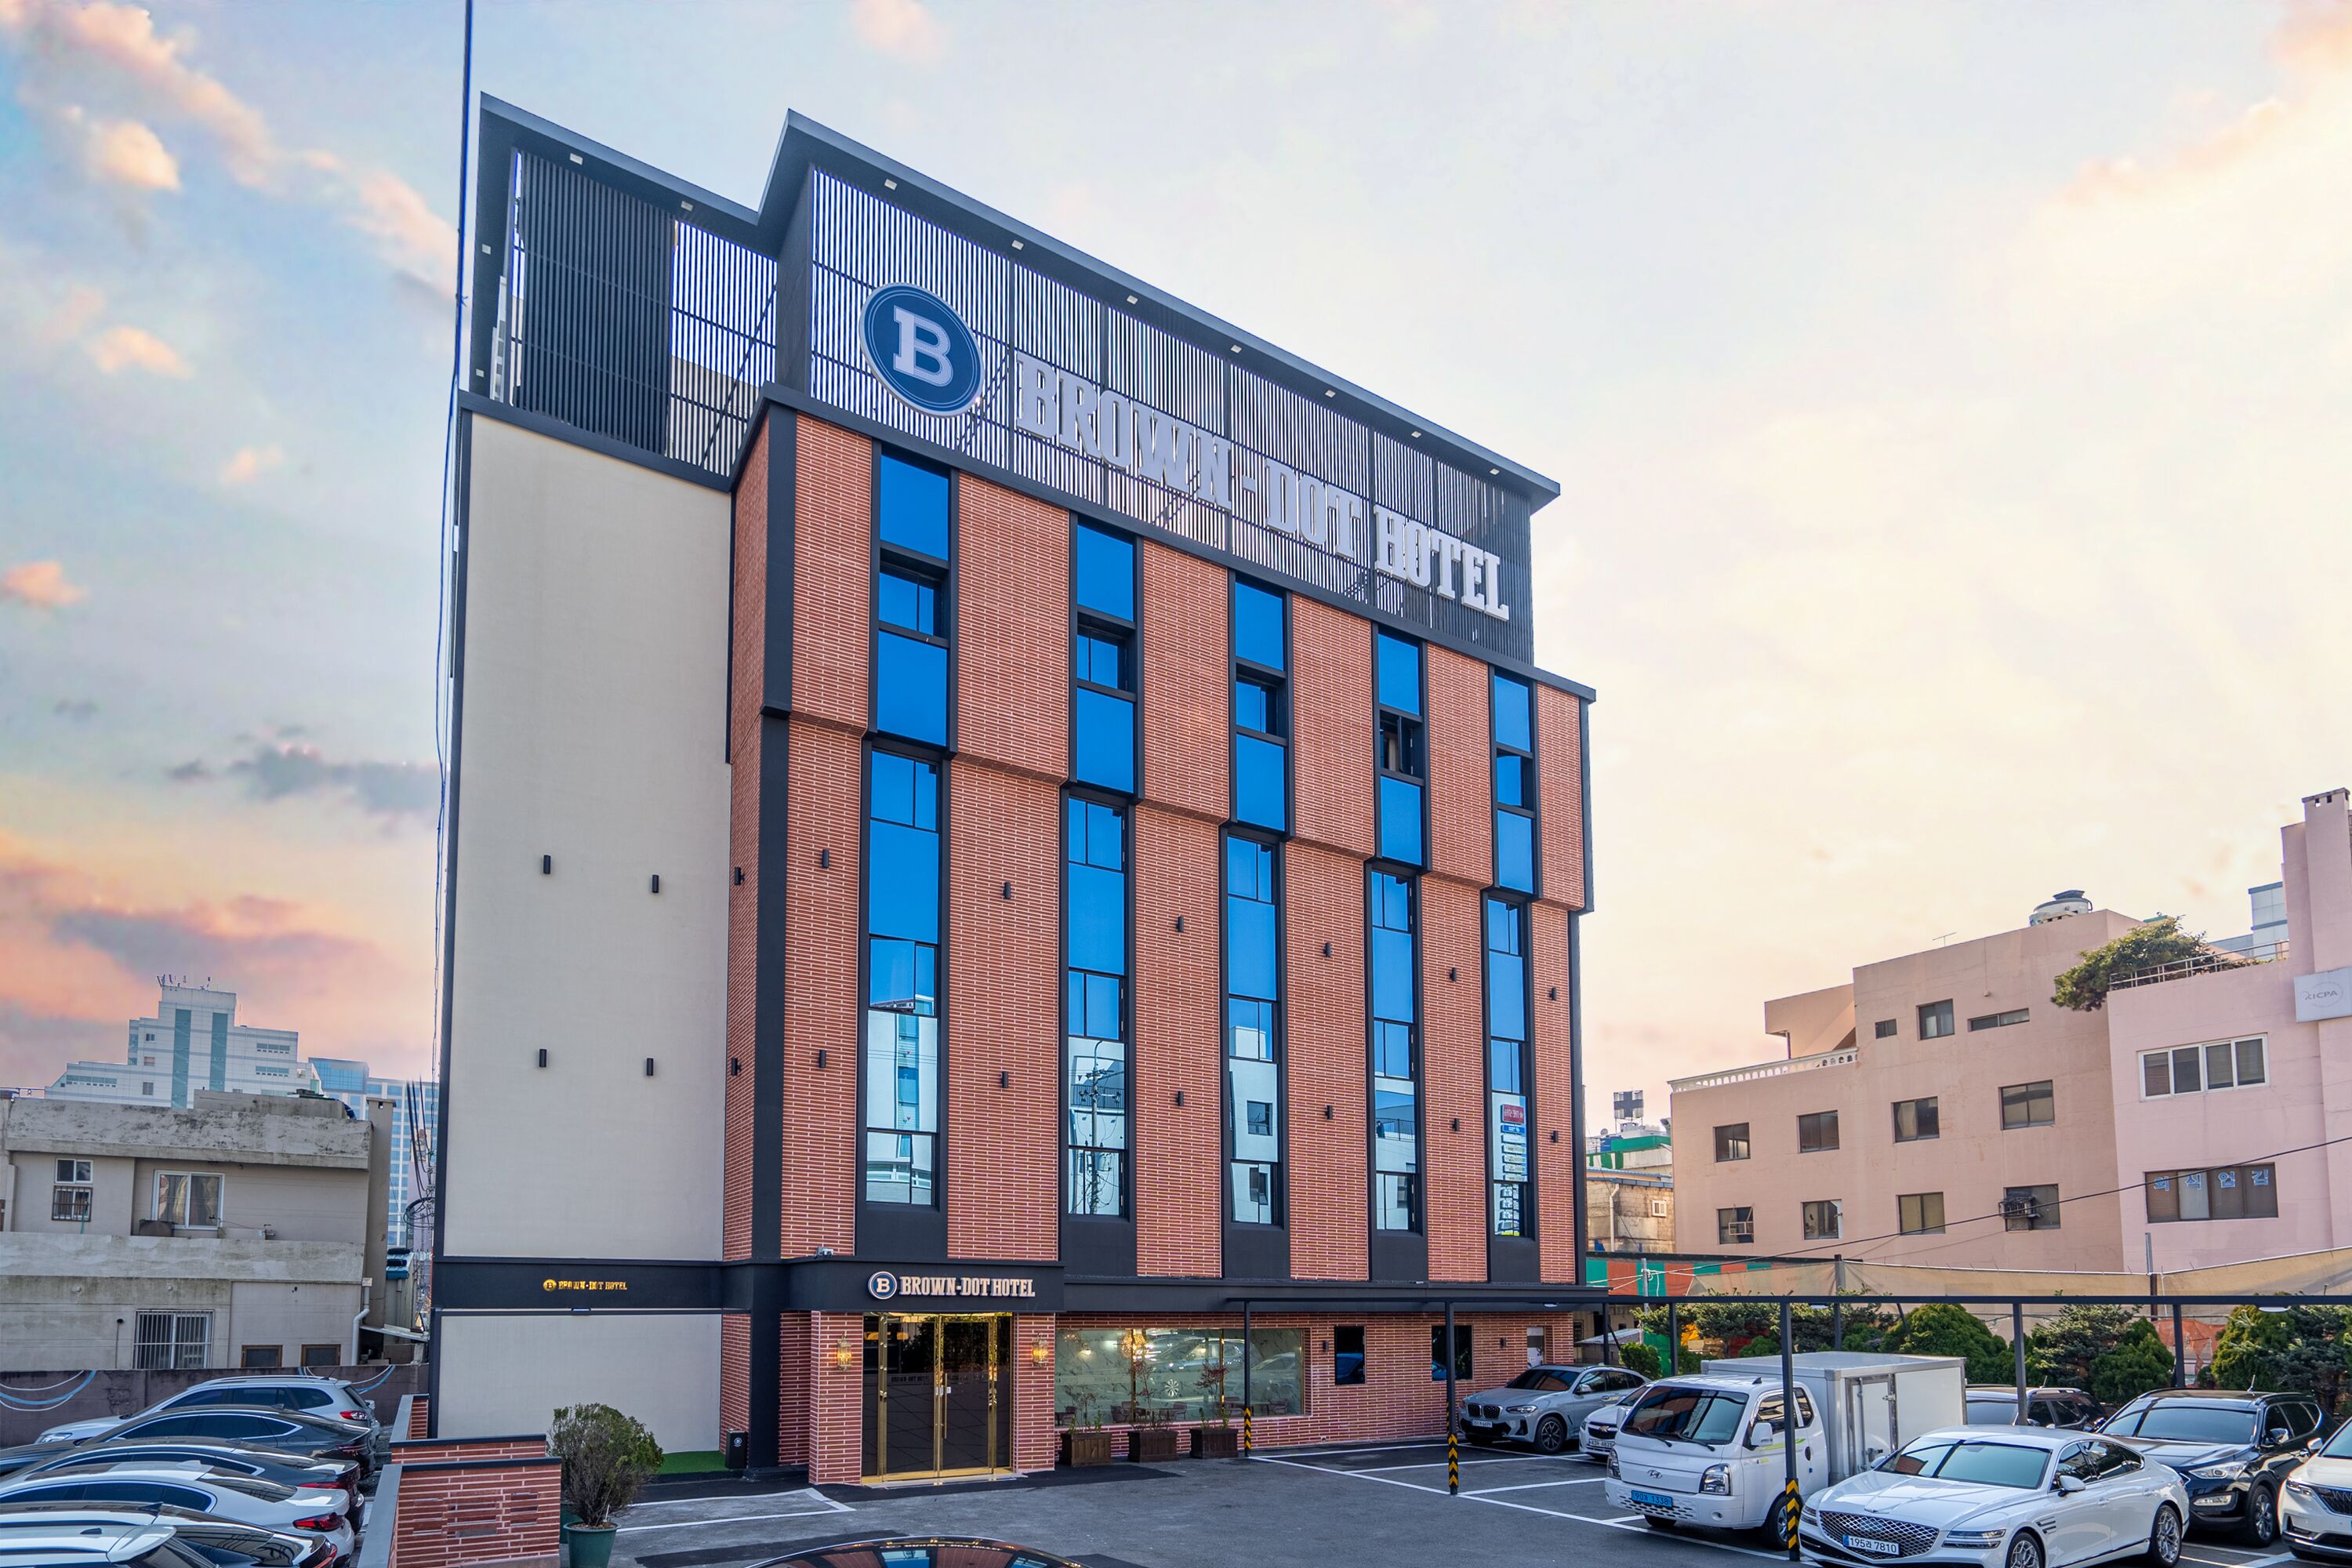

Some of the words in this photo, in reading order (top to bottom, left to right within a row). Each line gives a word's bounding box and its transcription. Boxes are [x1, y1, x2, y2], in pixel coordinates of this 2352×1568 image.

[894, 305, 953, 387] B
[1016, 350, 1361, 560] BROWN-DOT
[1374, 503, 1509, 622] HOTEL
[604, 1281, 627, 1290] HOTEL
[899, 1276, 990, 1296] BROWN-DOT
[990, 1278, 1036, 1298] HOTEL
[1651, 1495, 1668, 1505] 1338
[1850, 1537, 1872, 1548] 195라
[1874, 1541, 1896, 1553] 7810
